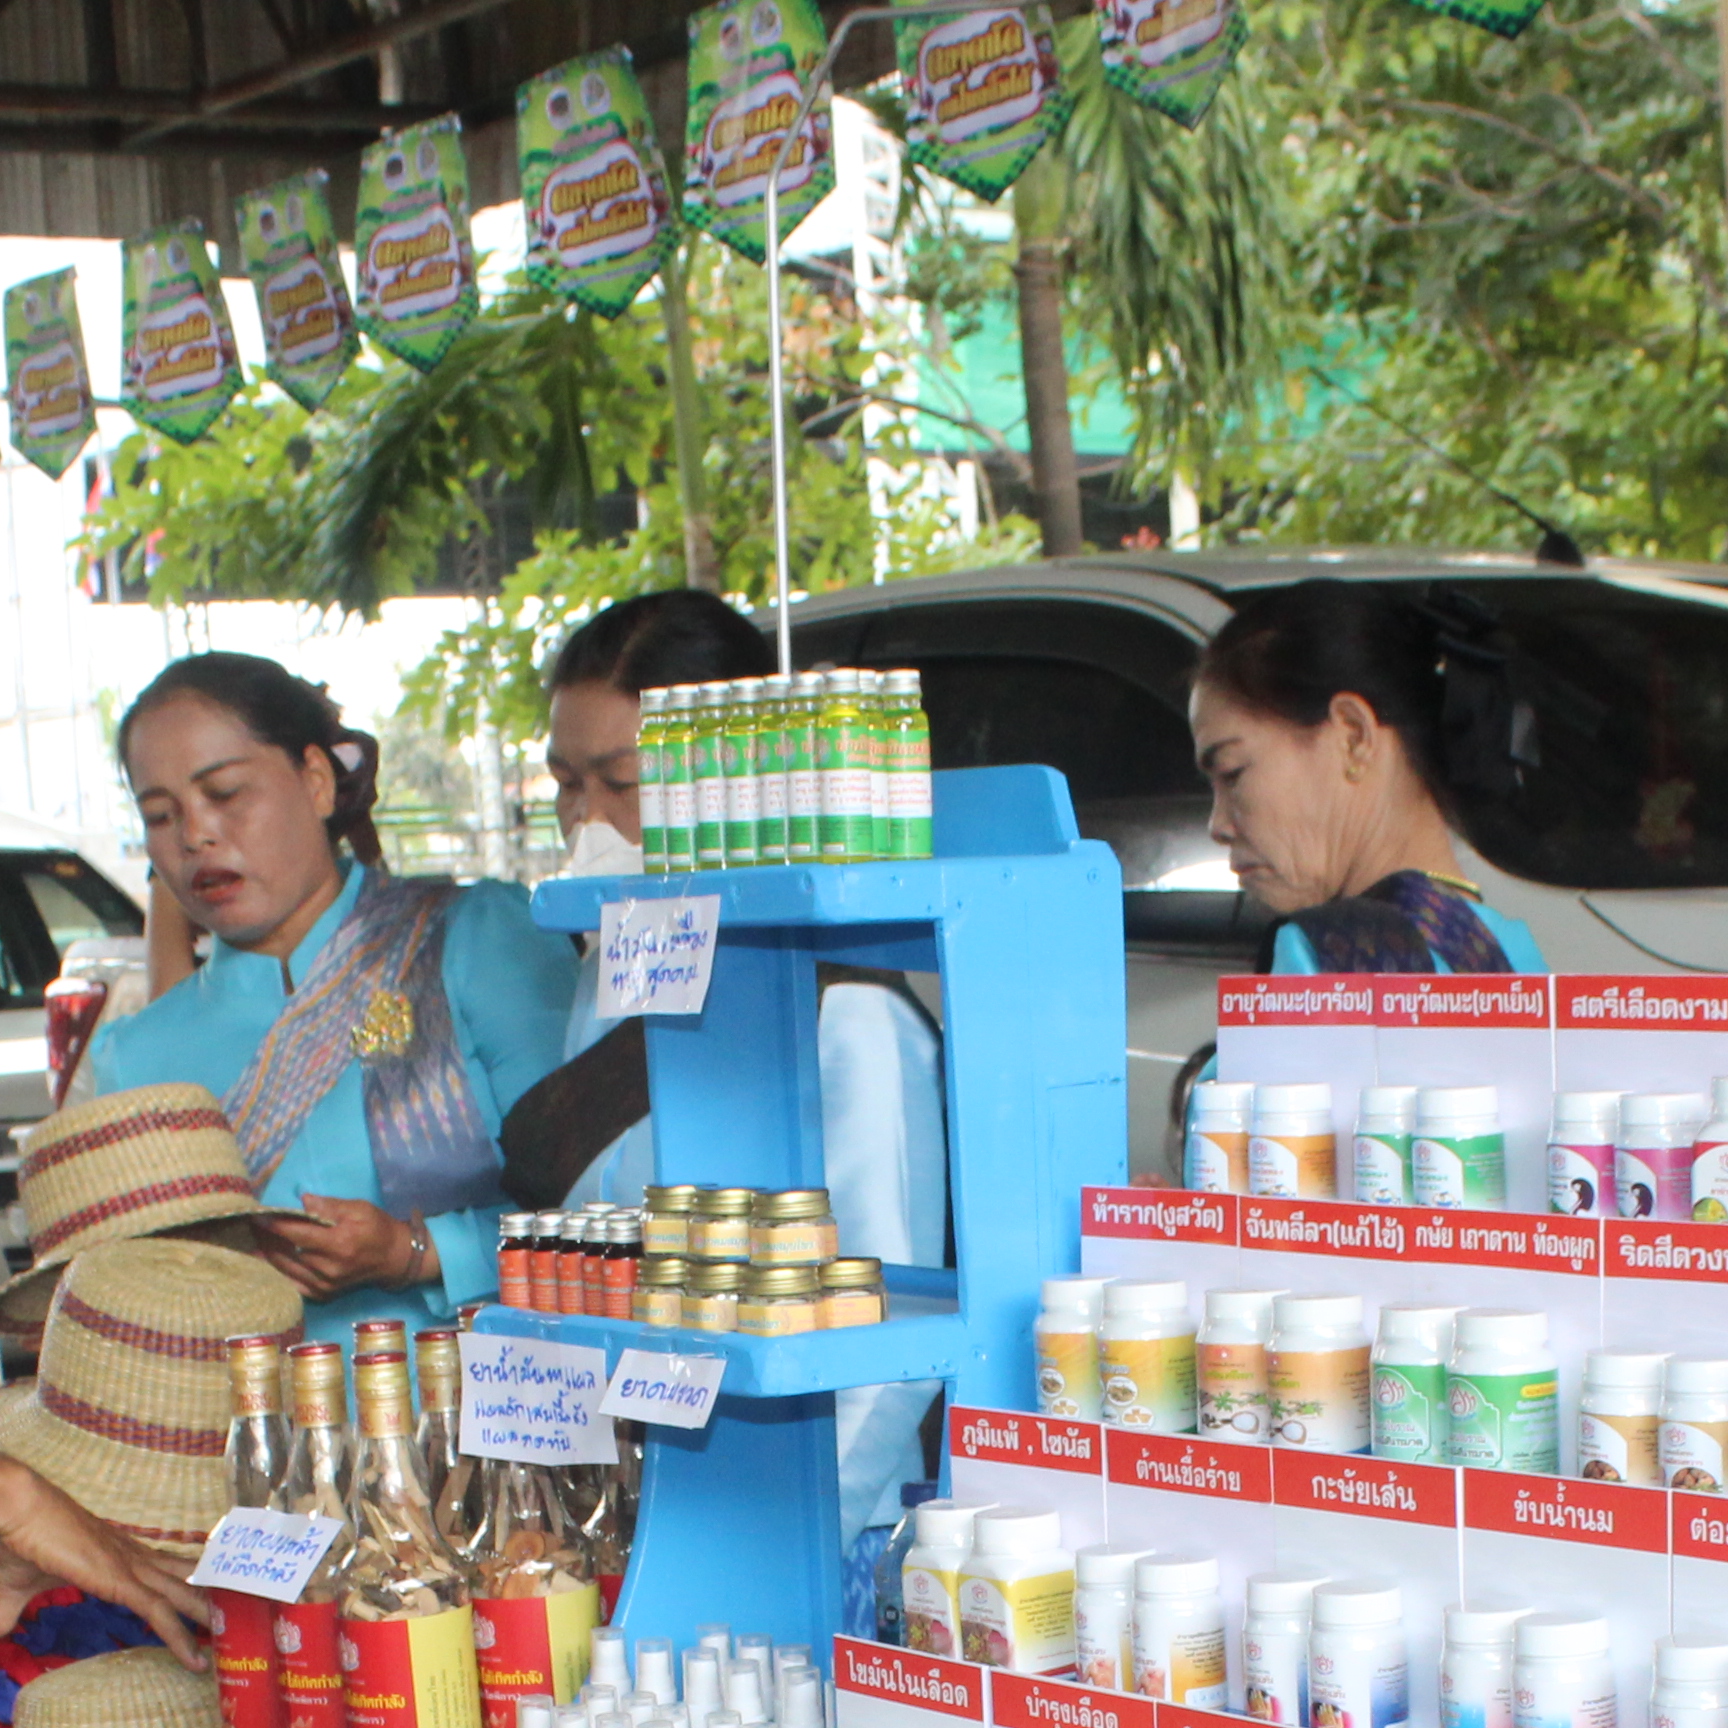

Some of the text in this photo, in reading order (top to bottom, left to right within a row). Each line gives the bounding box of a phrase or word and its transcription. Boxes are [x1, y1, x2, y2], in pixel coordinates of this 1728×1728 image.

[1221, 982, 1373, 1023] อายุวัฒนะ(ยาร้อน)
[1382, 980, 1544, 1024] อายุวัฒนะ(ยาเย็น)
[1571, 981, 1728, 1021] สตรีเลือดงาม
[1091, 1196, 1224, 1237] ห้าราก(งูสวัด)
[1245, 1207, 1405, 1254] จันทลีลา(แก้ไข้)
[1532, 1227, 1596, 1273] ท้องผูก
[962, 1419, 1020, 1457] ภูมิแพ้
[1038, 1422, 1093, 1460] ไซนัส
[1136, 1444, 1241, 1493] ต้านเชื้อร้าย
[1312, 1470, 1417, 1511] กะษัยเส้น
[1514, 1482, 1614, 1534] ขับน้ำนม
[846, 1650, 969, 1708] ไขมันในเลือด
